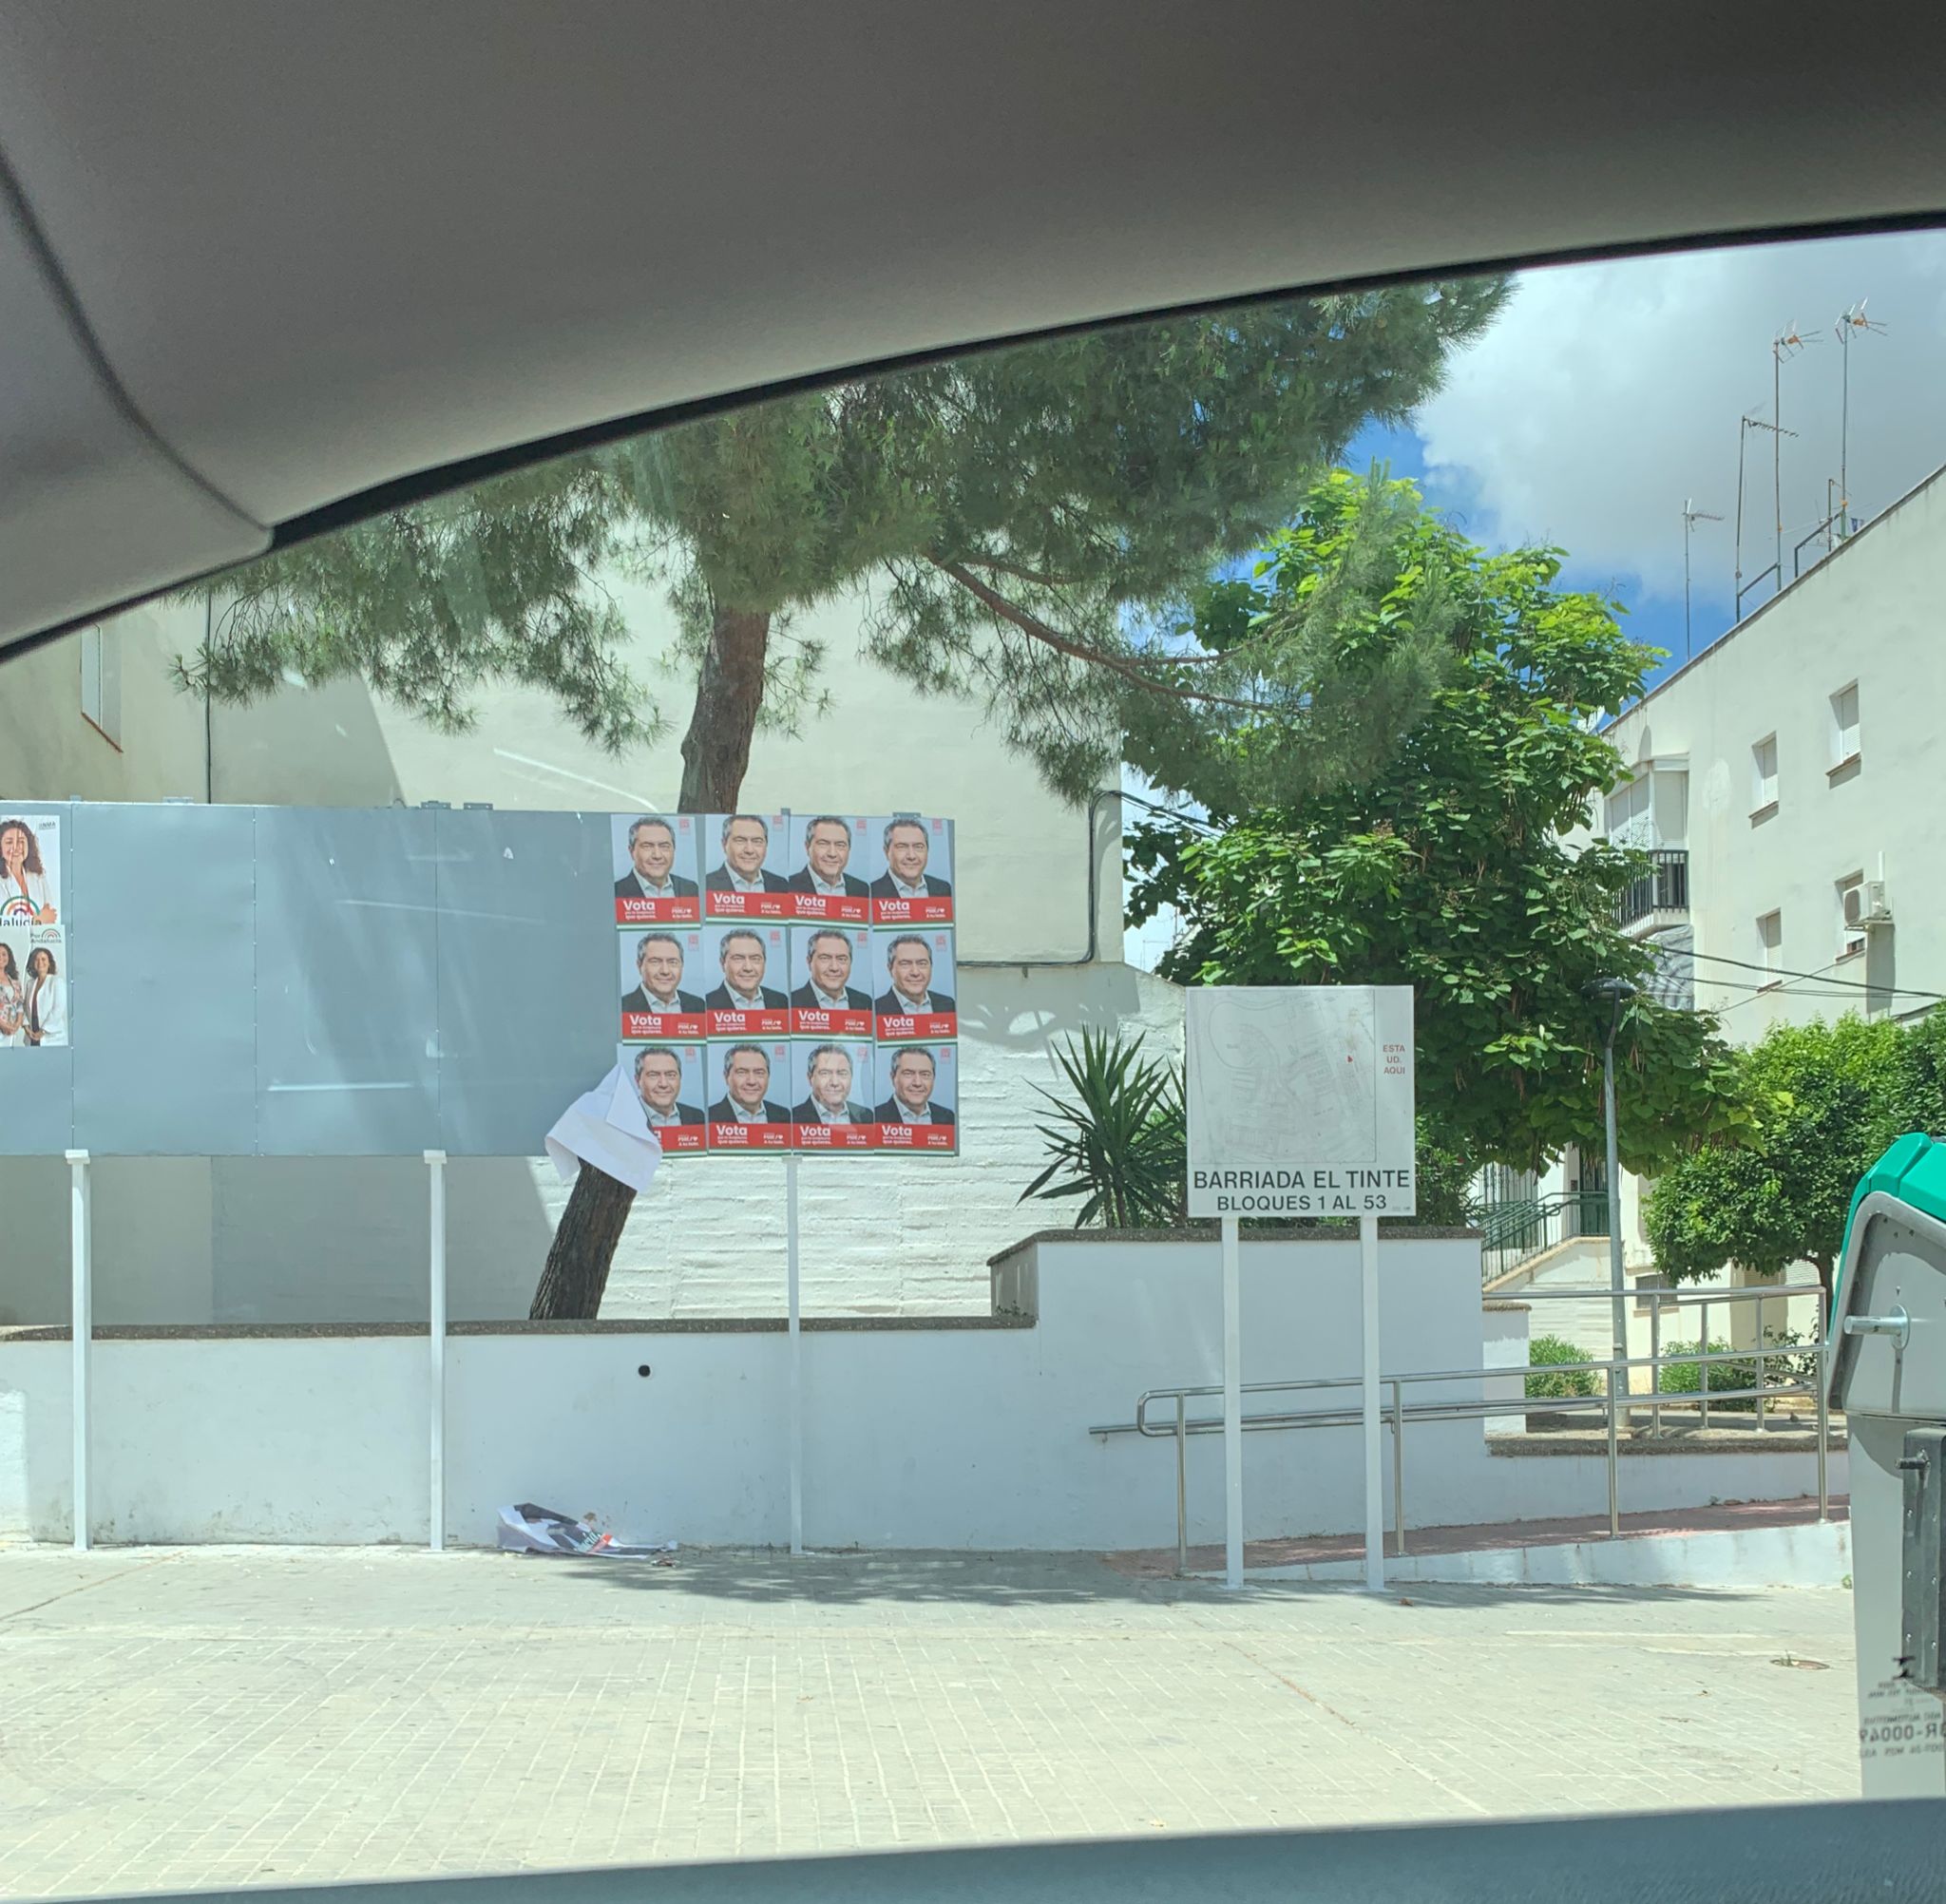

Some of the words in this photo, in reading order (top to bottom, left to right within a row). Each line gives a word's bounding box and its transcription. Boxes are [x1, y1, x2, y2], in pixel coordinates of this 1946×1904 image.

[713, 893, 745, 904] Vota
[794, 895, 826, 907] Vota
[622, 900, 656, 911] Vota
[879, 900, 909, 911] Vota
[629, 1015, 661, 1025] Vota
[714, 1012, 745, 1022] Vota
[798, 1010, 830, 1021] Vota
[883, 1017, 914, 1027] Vota
[1383, 1044, 1405, 1053] ESTA
[1383, 1066, 1405, 1075] AQUI
[715, 1125, 748, 1135] Vota
[799, 1125, 831, 1136] Vota
[882, 1125, 912, 1136] Vota
[1193, 1171, 1306, 1189] BARRIADA
[1314, 1171, 1341, 1189] EL
[1345, 1170, 1410, 1188] TINTE
[1217, 1195, 1311, 1211] BLOQUES
[1317, 1195, 1325, 1209] 1
[1332, 1194, 1357, 1209] AL
[1364, 1194, 1386, 1209] 53
